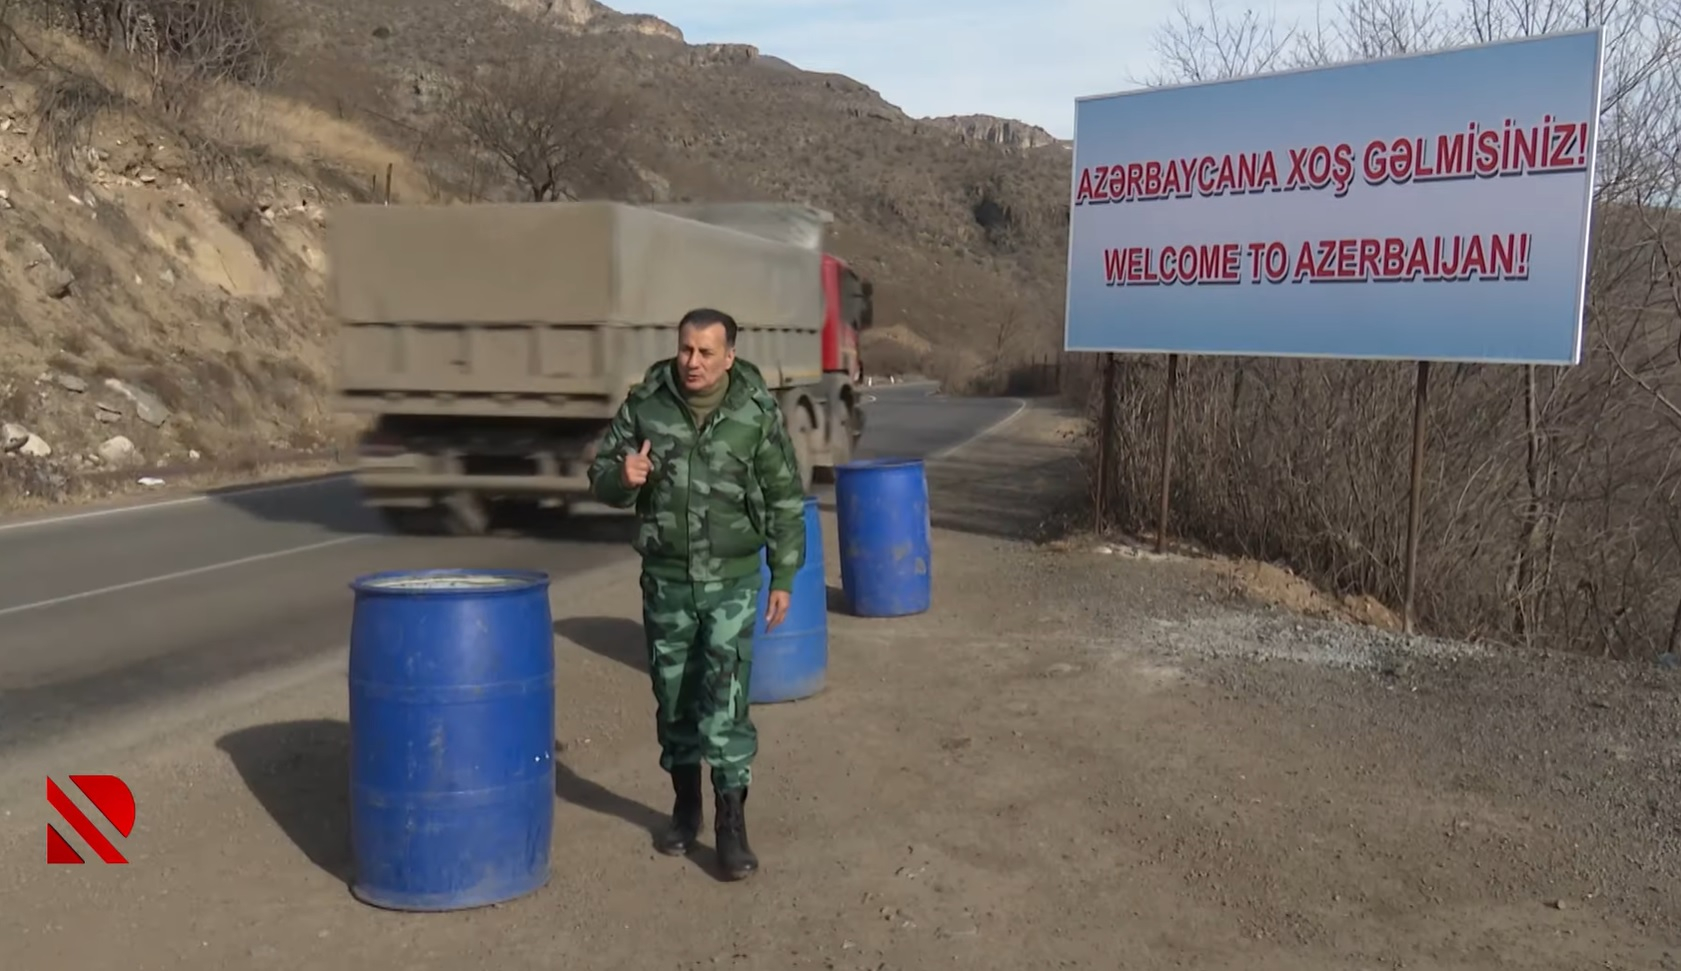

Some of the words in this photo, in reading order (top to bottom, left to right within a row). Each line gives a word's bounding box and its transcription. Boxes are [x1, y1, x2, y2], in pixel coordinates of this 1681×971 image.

[1076, 150, 1279, 202] AZƏRBAYCANA
[1286, 145, 1353, 193] XOŞ
[1362, 114, 1588, 182] GƏLMİSİNİZ!
[1103, 243, 1240, 283] WELCOME
[1248, 241, 1288, 282] TO
[1294, 233, 1529, 281] AZERBAIJAN!
